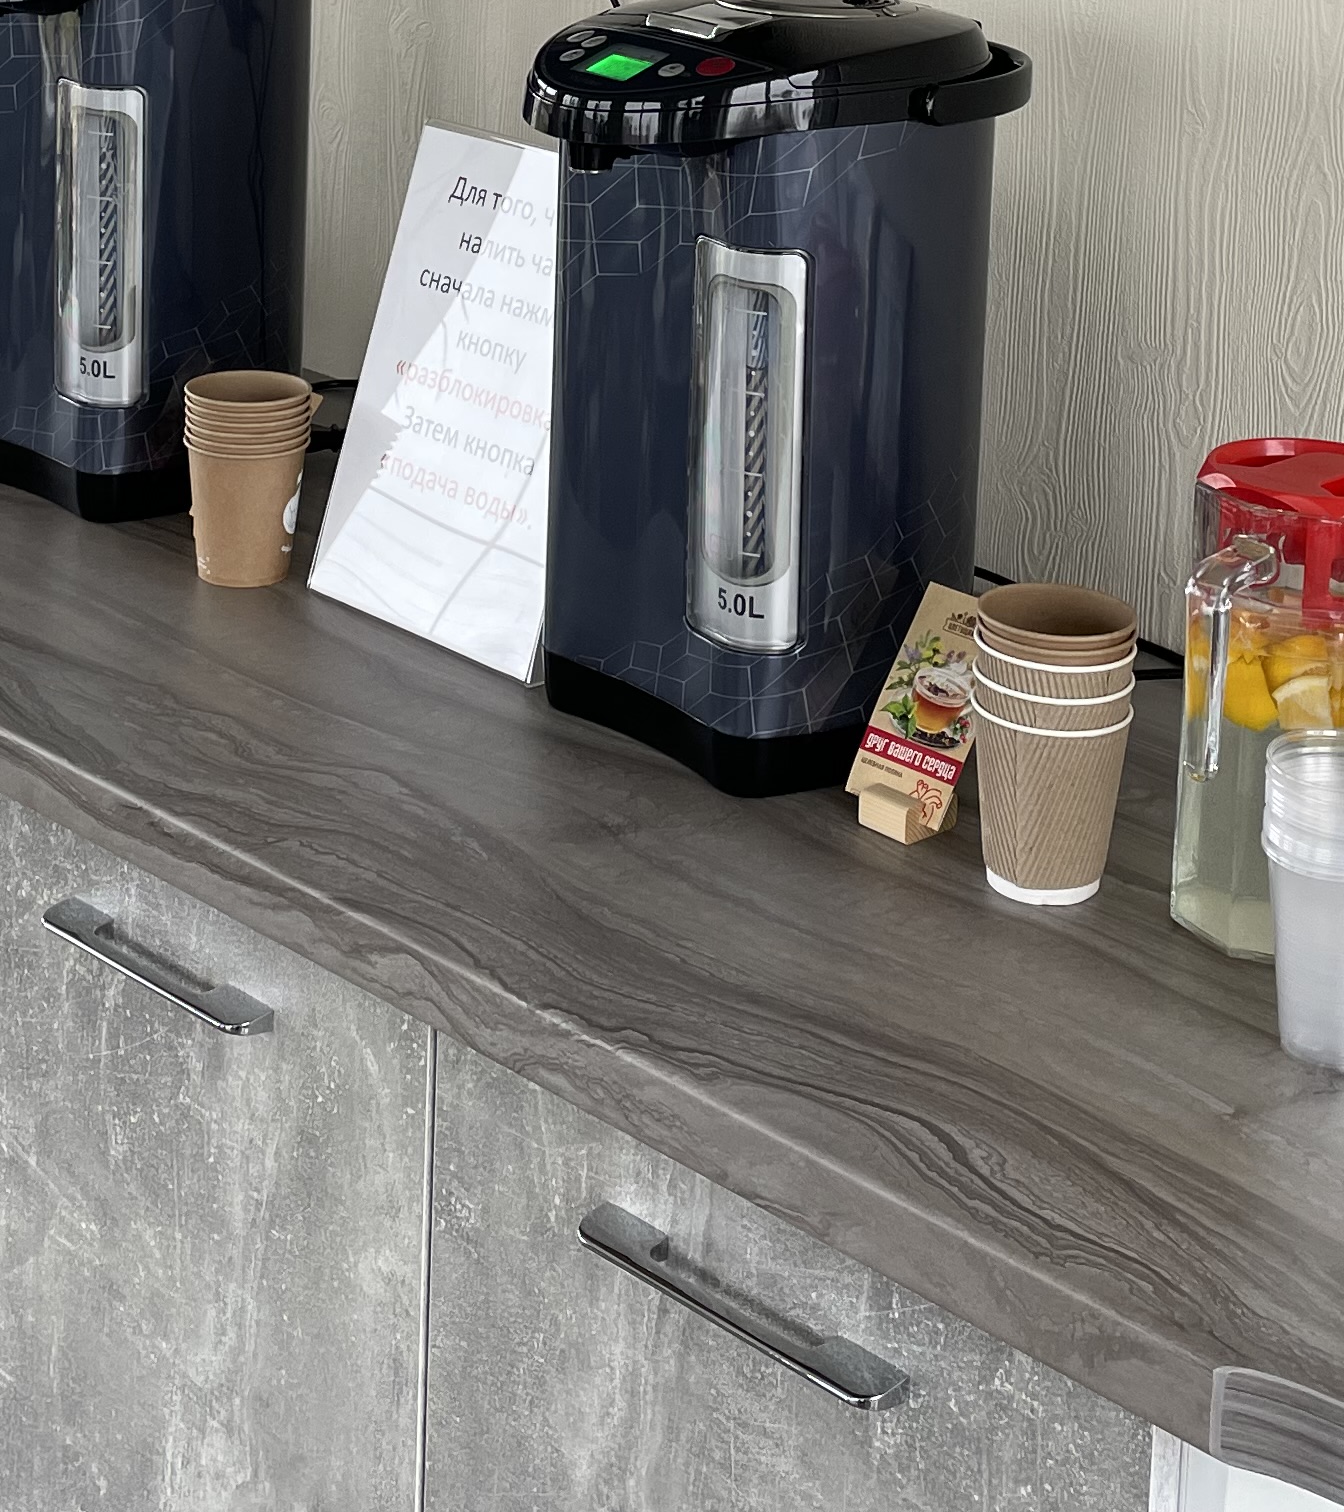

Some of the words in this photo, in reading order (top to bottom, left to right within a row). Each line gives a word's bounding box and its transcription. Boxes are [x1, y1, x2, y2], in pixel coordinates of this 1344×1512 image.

[448, 176, 488, 207] Для
[492, 192, 537, 227] того,
[459, 232, 526, 269] налить
[532, 253, 554, 277] ча
[419, 269, 496, 309] сначала
[500, 294, 554, 329] нажм
[79, 355, 116, 379] 5.0L
[456, 330, 527, 375] кнопку
[396, 359, 551, 432] «разблокировка
[402, 406, 460, 449] Затем
[464, 434, 535, 476] кнопка
[717, 586, 765, 620] 5.0L
